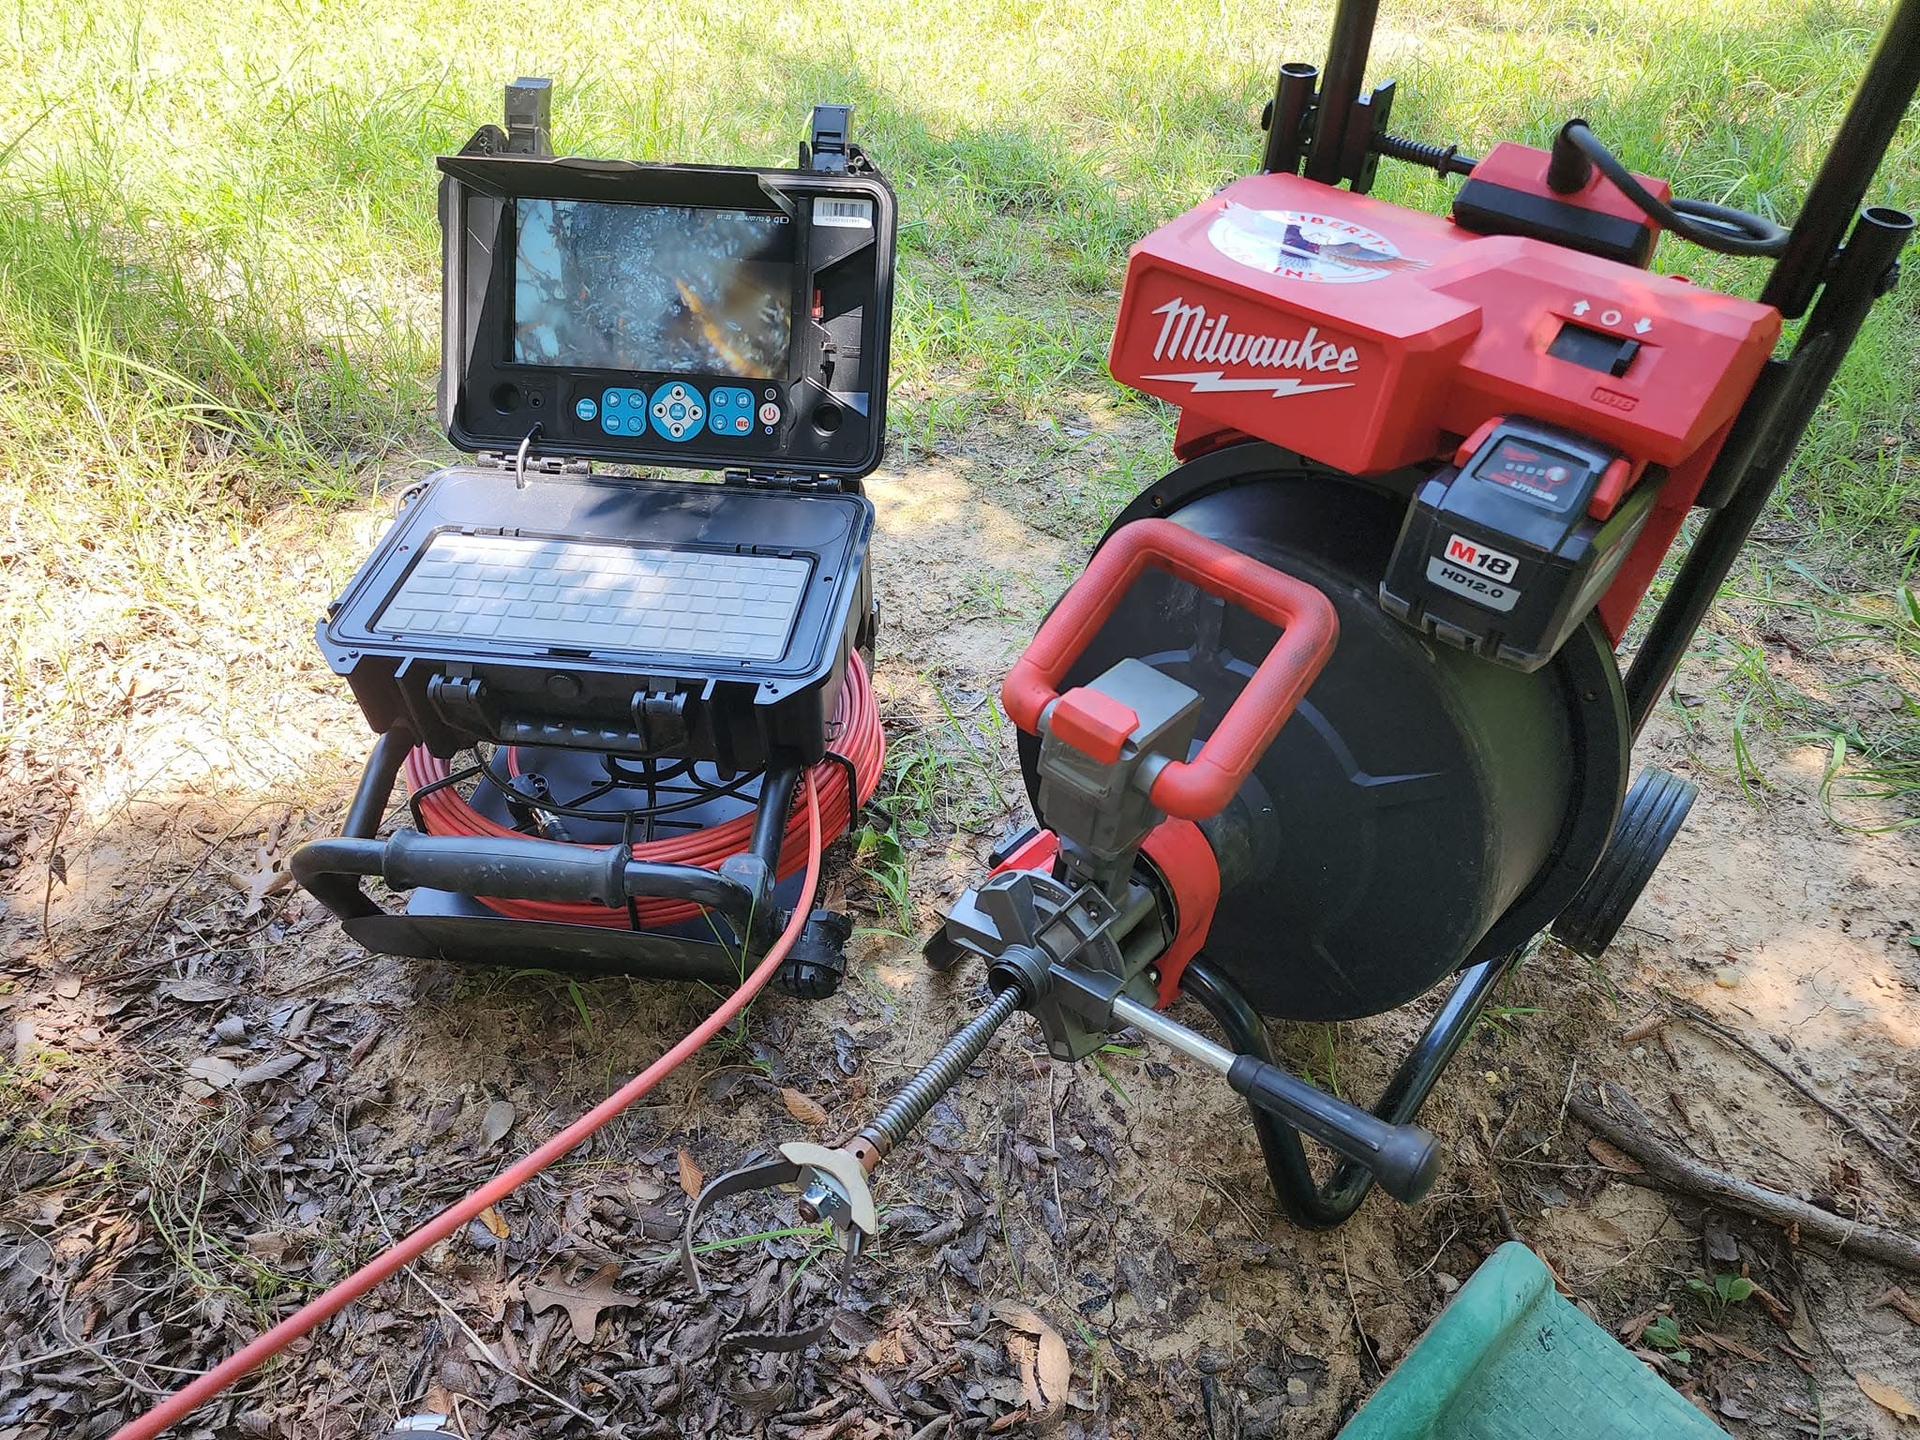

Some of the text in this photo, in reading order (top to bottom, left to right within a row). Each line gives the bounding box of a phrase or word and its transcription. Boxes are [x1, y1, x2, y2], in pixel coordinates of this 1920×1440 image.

[1287, 212, 1389, 248] LIBERTY
[1151, 296, 1359, 373] Milwaukee
[737, 420, 748, 428] REC
[1449, 540, 1512, 575] M18
[1440, 567, 1504, 599] HD12.0
